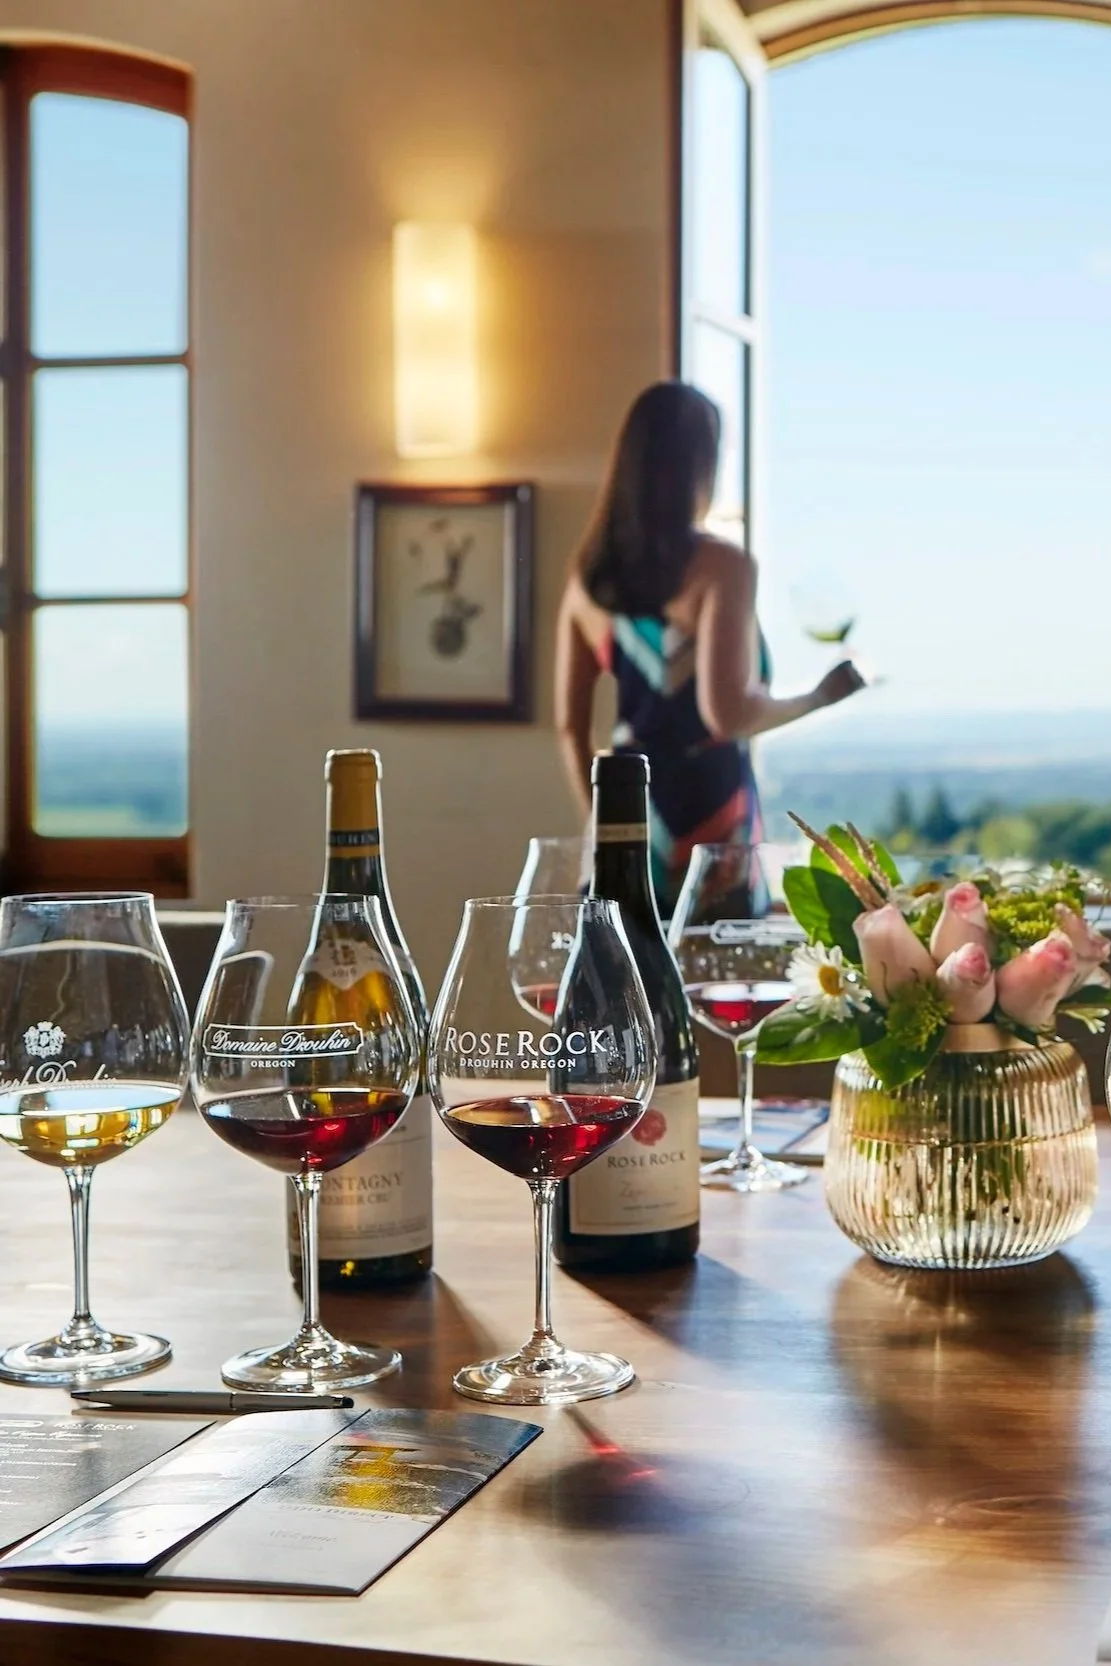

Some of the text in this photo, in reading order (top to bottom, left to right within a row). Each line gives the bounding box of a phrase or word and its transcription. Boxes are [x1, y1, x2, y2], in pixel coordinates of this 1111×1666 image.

[211, 1029, 351, 1053] Domaine Drouhin
[251, 1060, 296, 1068] OREGON
[460, 1057, 576, 1070] DROUHIN OREGON
[320, 1170, 404, 1192] ONTAGNY
